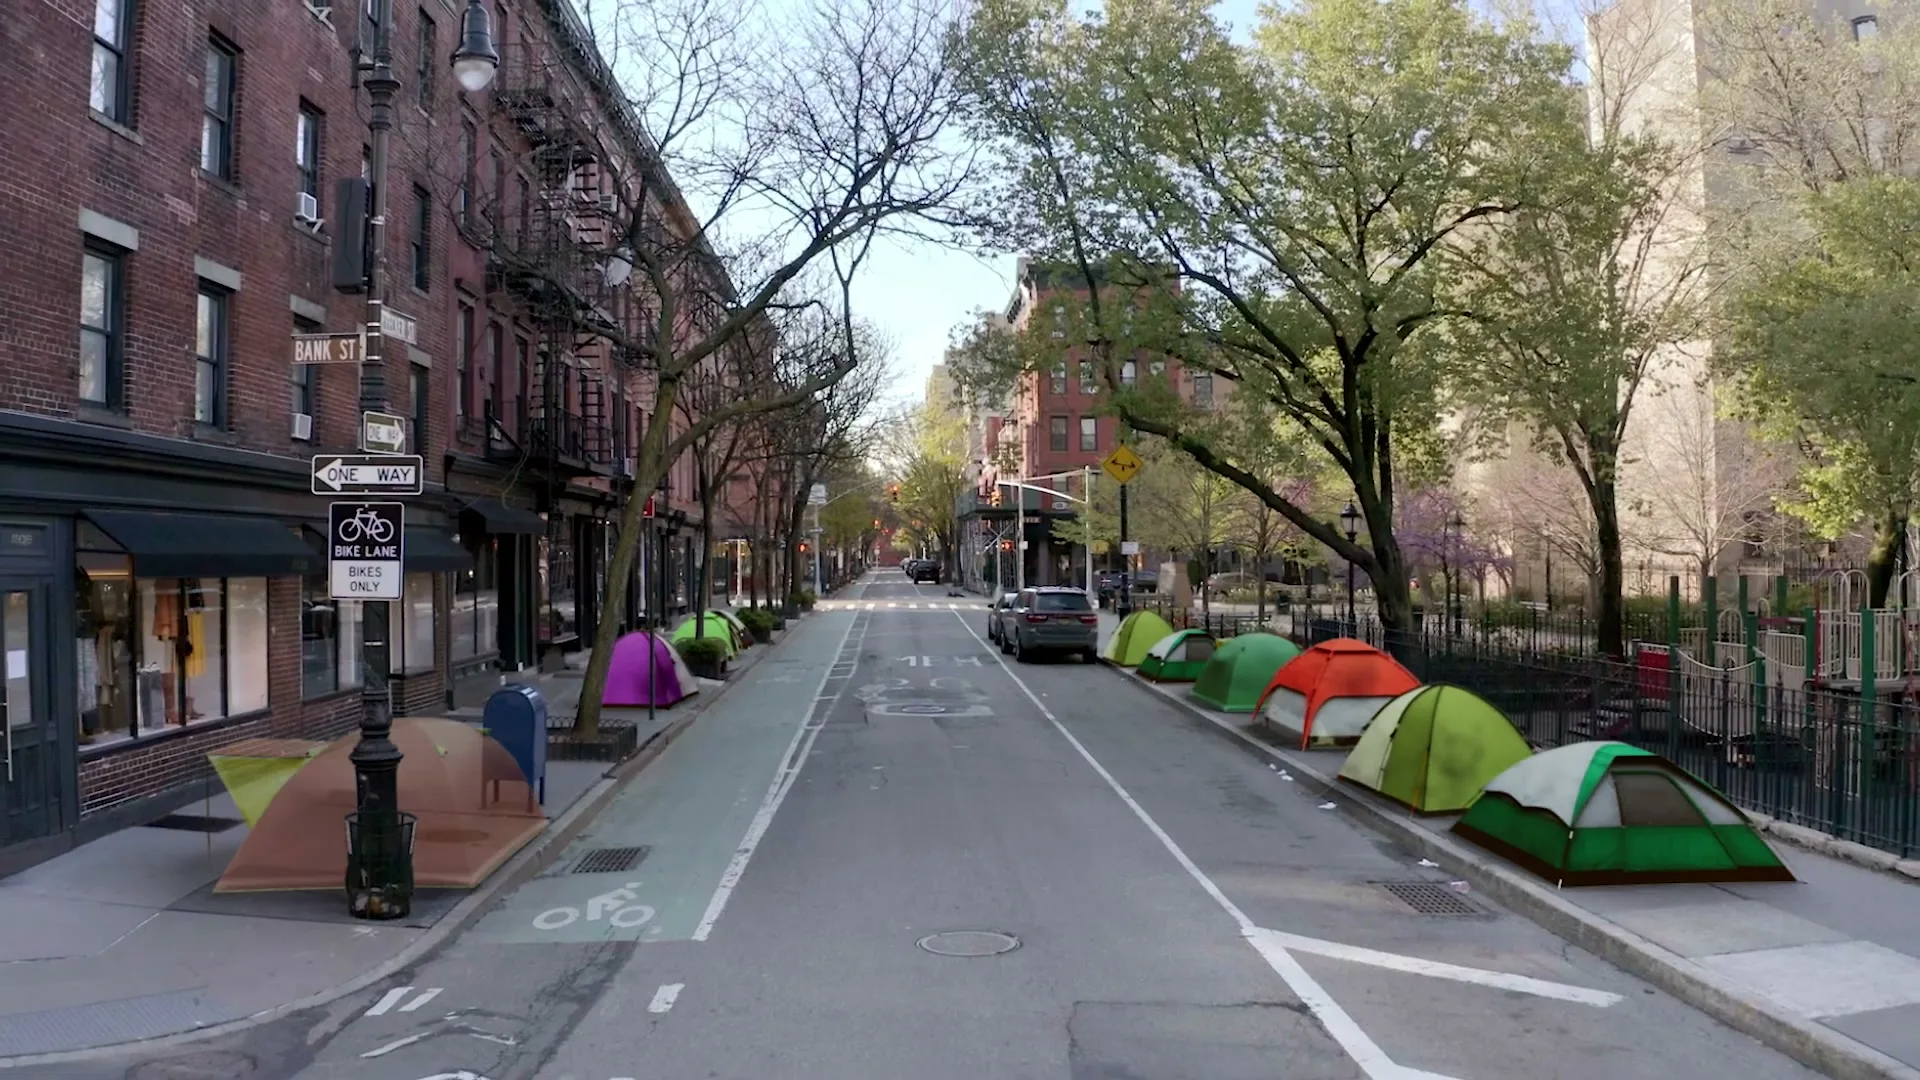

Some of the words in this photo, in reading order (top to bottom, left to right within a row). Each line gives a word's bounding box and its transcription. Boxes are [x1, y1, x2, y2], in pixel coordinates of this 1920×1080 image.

[295, 340, 332, 361] BANK
[339, 339, 356, 360] ST
[327, 468, 358, 481] ONE
[377, 468, 411, 481] WAY
[334, 545, 361, 557] BIKE
[365, 545, 397, 557] LANE
[348, 566, 382, 577] BIKES
[350, 581, 380, 592] ONLY
